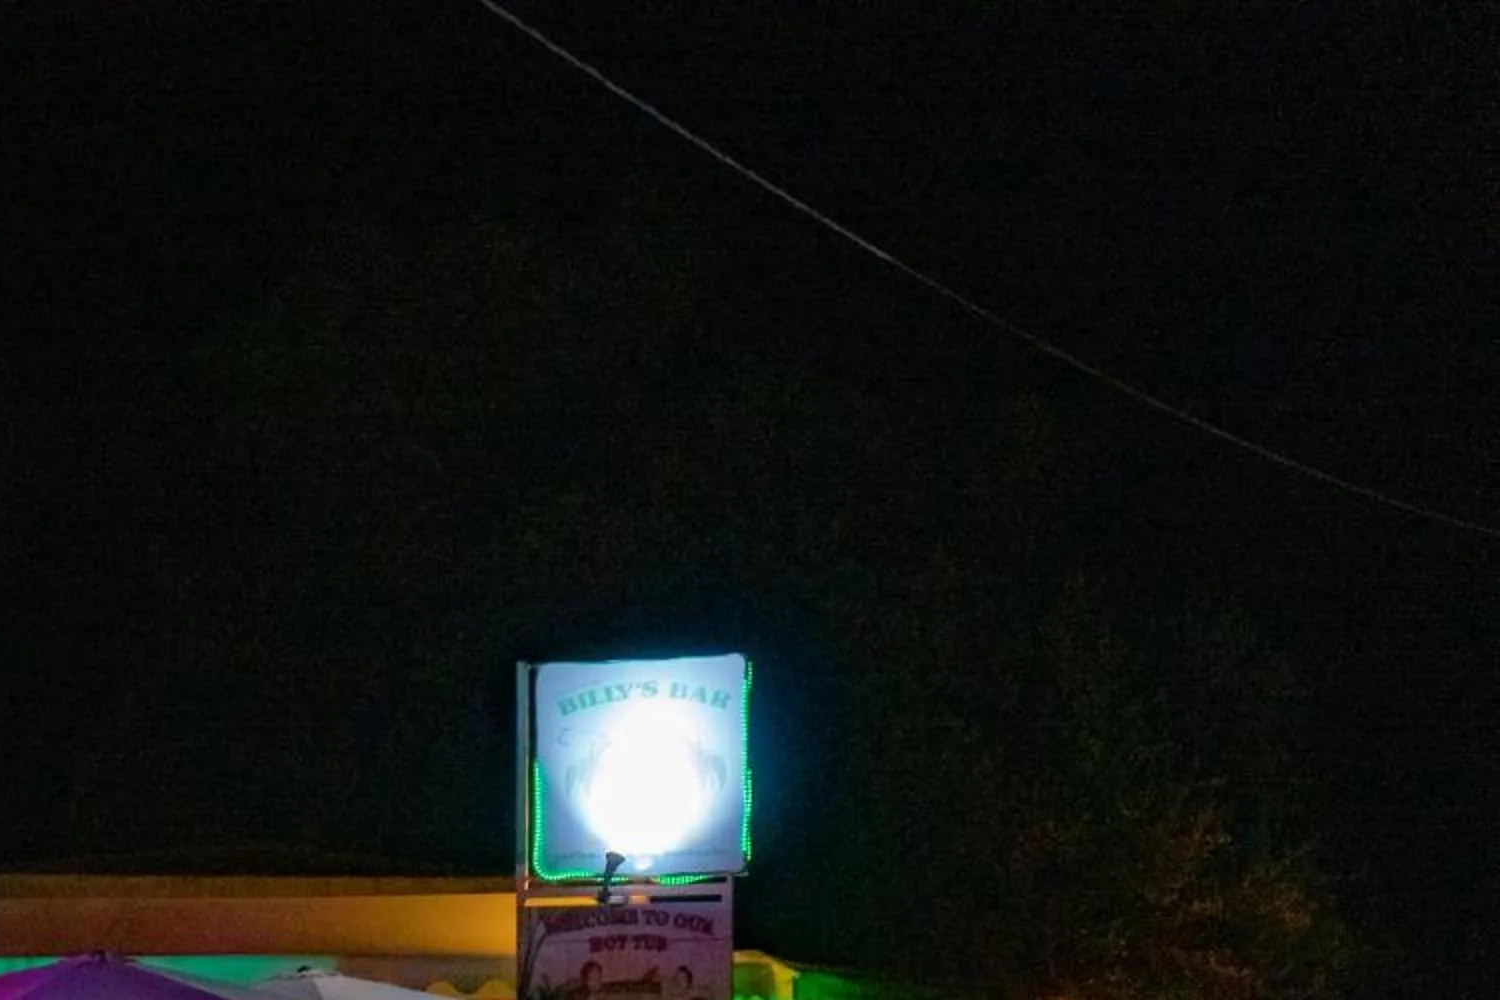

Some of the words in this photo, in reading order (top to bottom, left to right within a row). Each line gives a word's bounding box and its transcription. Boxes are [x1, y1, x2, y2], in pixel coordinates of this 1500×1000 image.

[557, 681, 659, 716] BILLY'S
[669, 682, 731, 710] BAR
[642, 909, 669, 926] TO
[674, 912, 715, 936] OUR
